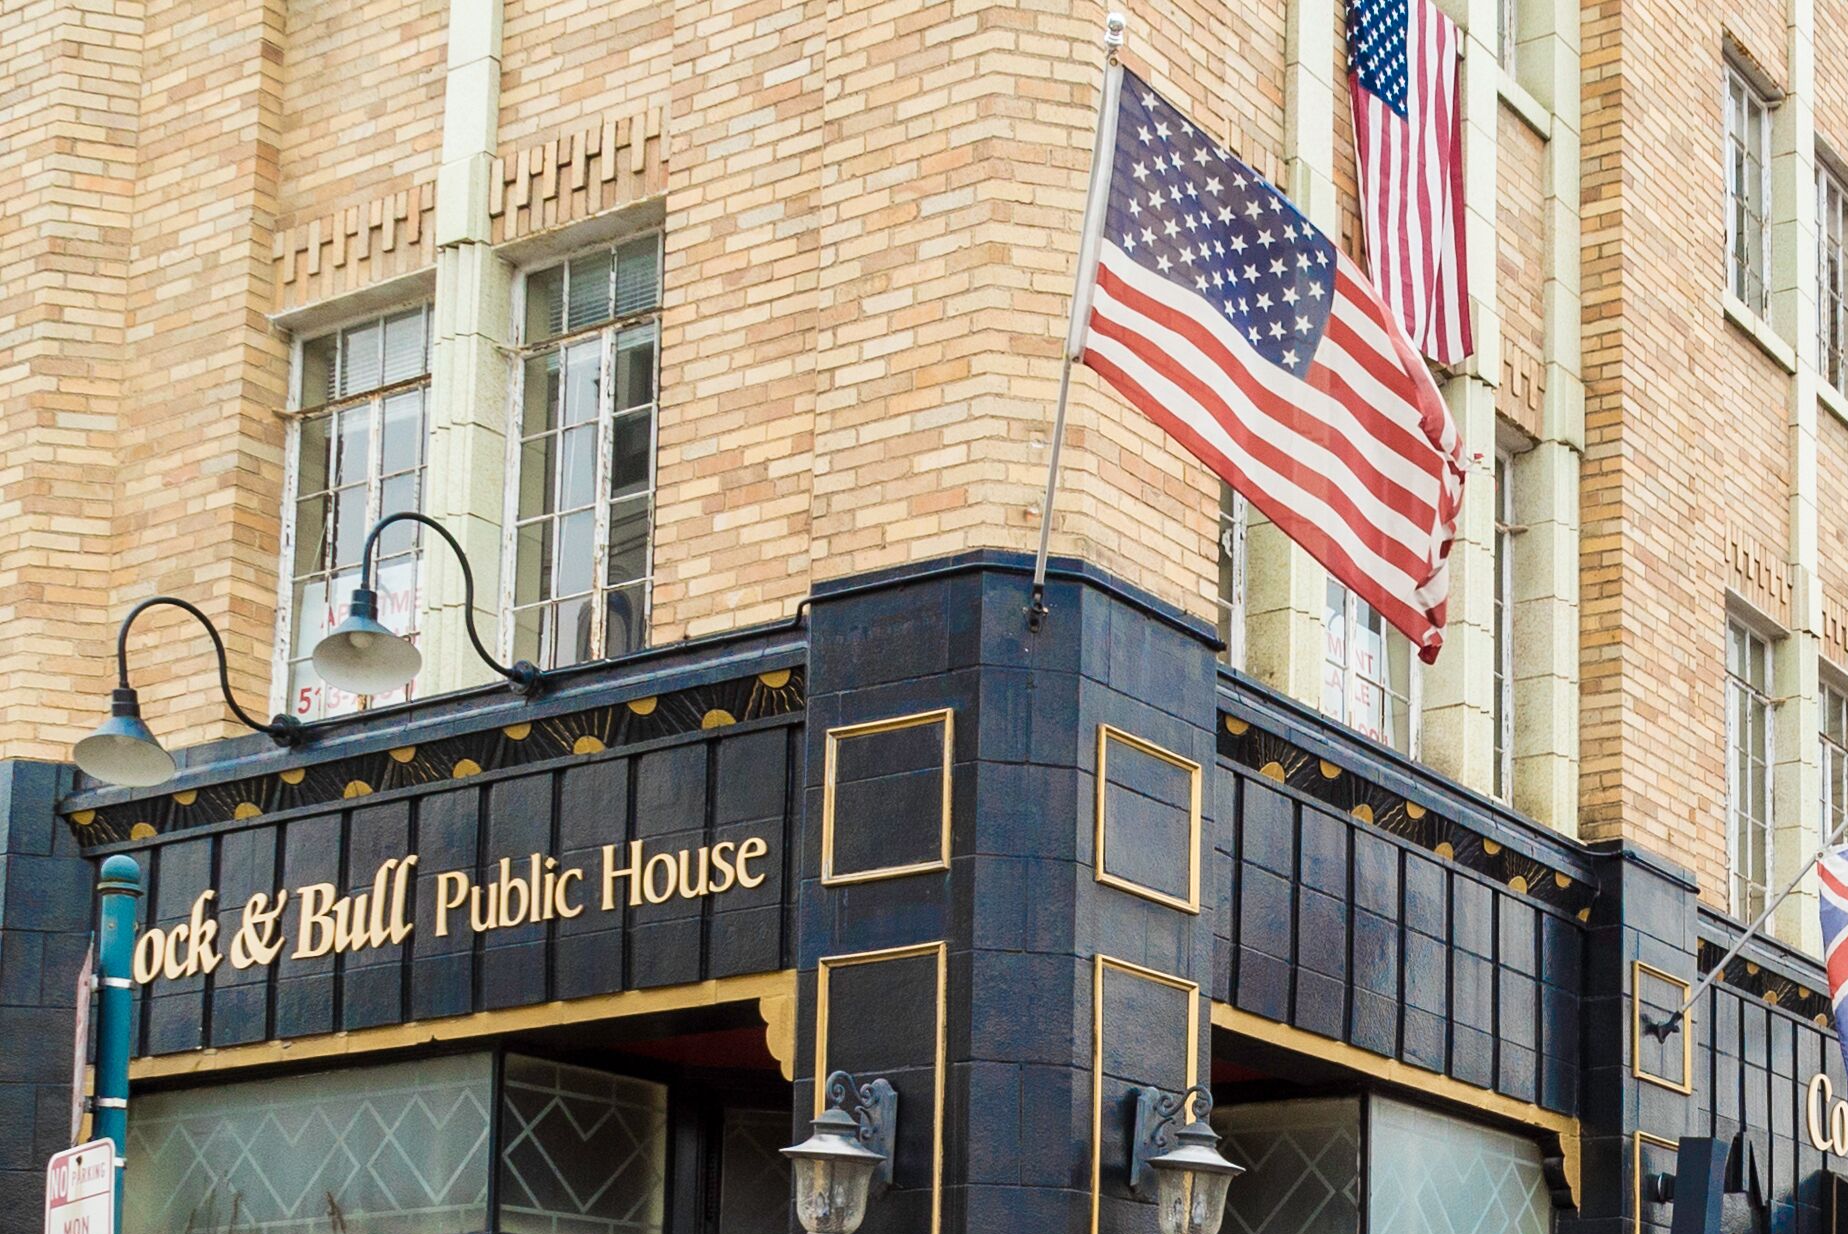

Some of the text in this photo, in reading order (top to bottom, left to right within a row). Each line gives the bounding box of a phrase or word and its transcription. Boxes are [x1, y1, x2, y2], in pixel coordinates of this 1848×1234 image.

[132, 837, 768, 984] ock & Bull Public House
[51, 1161, 106, 1201] NO PARKING
